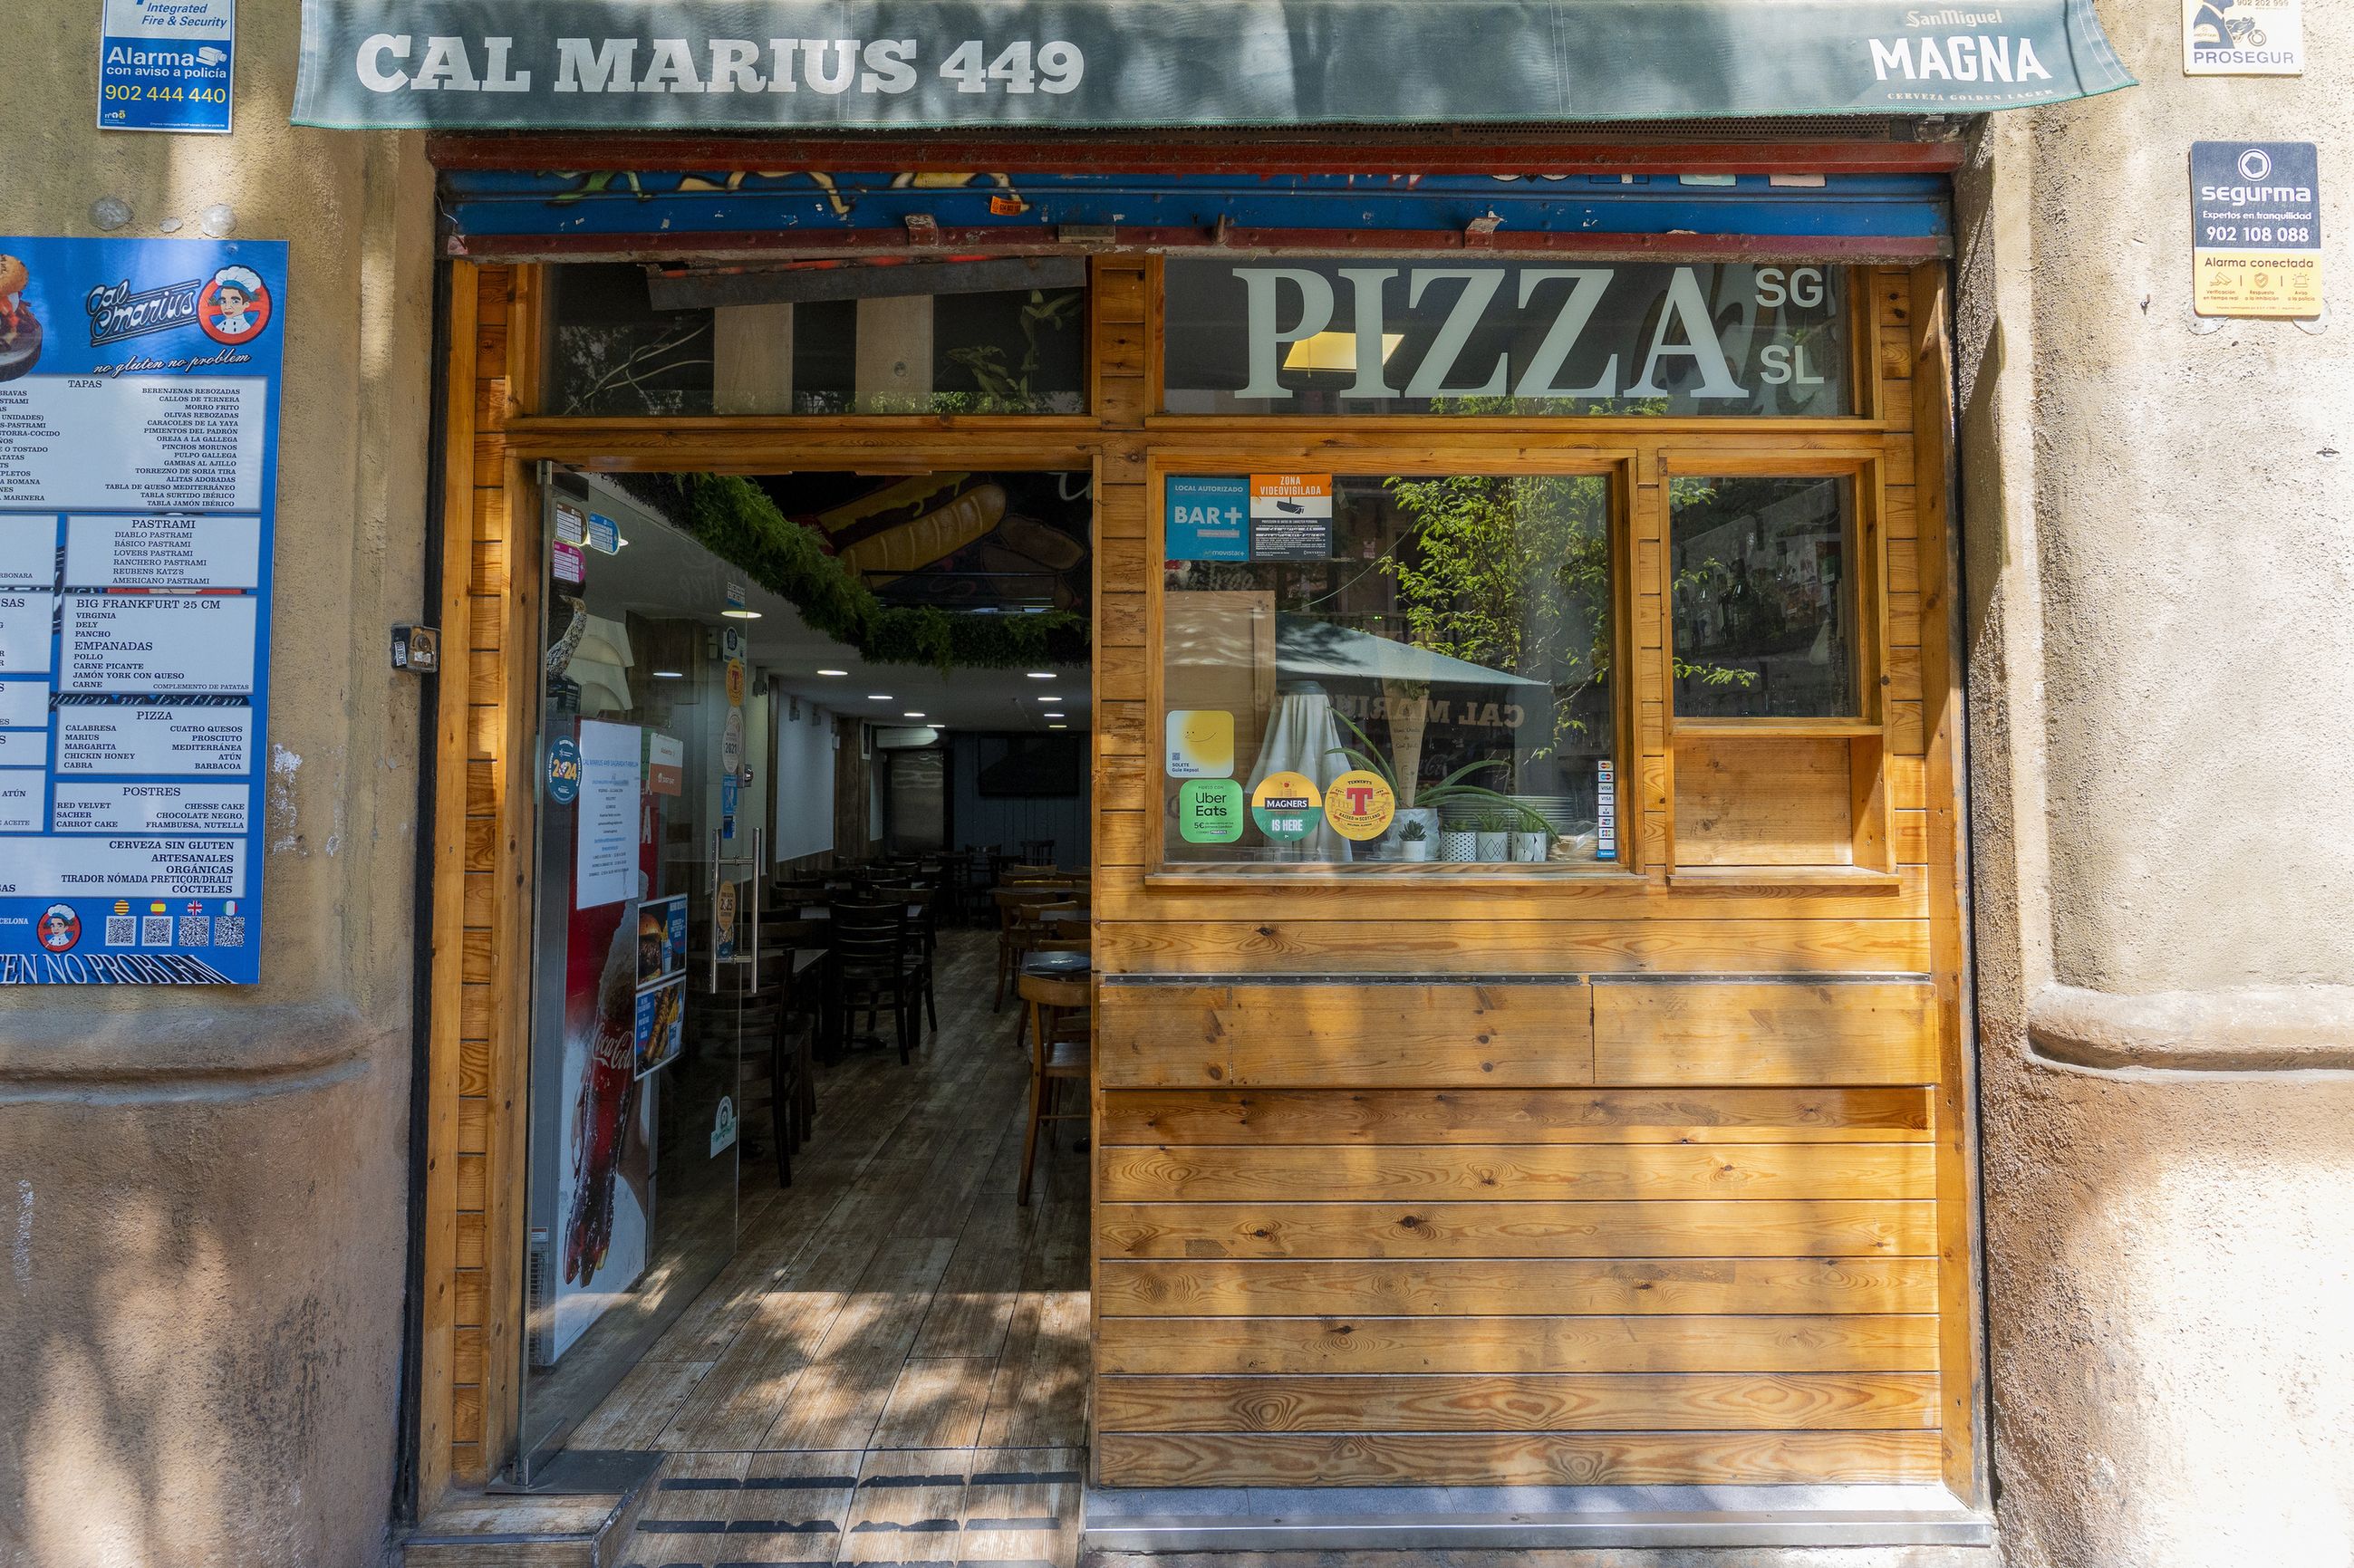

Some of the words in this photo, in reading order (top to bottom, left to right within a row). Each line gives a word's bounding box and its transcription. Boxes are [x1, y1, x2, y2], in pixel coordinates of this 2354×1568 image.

[147, 3, 207, 14] Integrated
[141, 15, 165, 25] Fire
[167, 16, 177, 26] &
[179, 16, 227, 29] Security
[107, 46, 195, 67] Alarma
[1868, 35, 2053, 83] MAGNA
[2194, 51, 2294, 64] PROSEGUR
[356, 34, 531, 93] CAL
[554, 37, 918, 95] MARIUS
[939, 40, 1085, 95] 449
[106, 67, 131, 76] con
[135, 66, 170, 77] aviso
[173, 69, 181, 77] a
[184, 67, 227, 80] policía
[105, 84, 142, 101] 902
[146, 86, 185, 101] 444
[188, 87, 227, 103] 440
[1887, 92, 1944, 101] CERVEZA
[2008, 89, 2054, 101] LAGER
[2201, 186, 2311, 207] segurma
[2203, 210, 2241, 221] Expertos
[2243, 212, 2254, 220] en
[2256, 210, 2312, 222] tranquilidad
[2206, 226, 2237, 242] 902
[2243, 226, 2272, 242] 108
[2277, 227, 2310, 243] 088
[2204, 257, 2246, 268] Alarma
[2250, 258, 2314, 269] conectada
[1755, 267, 1824, 309] SG
[1232, 267, 1750, 399] PIZZA
[93, 362, 112, 374] no
[112, 354, 164, 379] gluten
[168, 357, 188, 370] no
[185, 348, 252, 373] problem
[1759, 344, 1826, 386] SL
[67, 380, 102, 388] TAPAS
[1279, 476, 1301, 486] ZONA
[1260, 486, 1322, 495] VIDEOVIGILADA
[172, 498, 200, 507] JAMÓN
[202, 498, 235, 507] IBÉRICO
[131, 519, 196, 529] PASTRAMI
[76, 599, 100, 609] BIG
[101, 599, 179, 609] FRANKFURT
[183, 601, 198, 609] 25
[201, 600, 221, 609] CM
[74, 641, 153, 651] EMPANADAS
[72, 670, 104, 678] JAMÓN
[136, 711, 173, 720] PIZZA
[191, 735, 243, 743] PROSCIUTO
[172, 743, 242, 752] MEDITERRÁNEA
[218, 752, 242, 761] ATÚN
[122, 786, 181, 797] POSTRES
[1195, 792, 1227, 804] Uber
[1267, 799, 1307, 808] MAGNERS
[1346, 787, 1374, 816] T
[56, 811, 92, 819] SACHER
[1195, 804, 1228, 817] Eats
[1359, 812, 1382, 822] SCOTLAND
[55, 820, 92, 828] CARROT
[1194, 822, 1205, 830] 5€
[1271, 819, 1280, 832] IS
[1282, 819, 1304, 832] HERE
[109, 841, 162, 850] CERVEZA
[165, 841, 185, 850] SIN
[188, 841, 235, 850] GLUTEN
[150, 853, 234, 862] ARTESANALES
[166, 863, 234, 874] ORGÁNICAS
[61, 874, 104, 883] TIRADOR
[107, 871, 149, 883] NÓMADA
[172, 882, 233, 893] CÓCTELES
[43, 954, 89, 985] NO
[84, 954, 239, 985] PROBLEM
